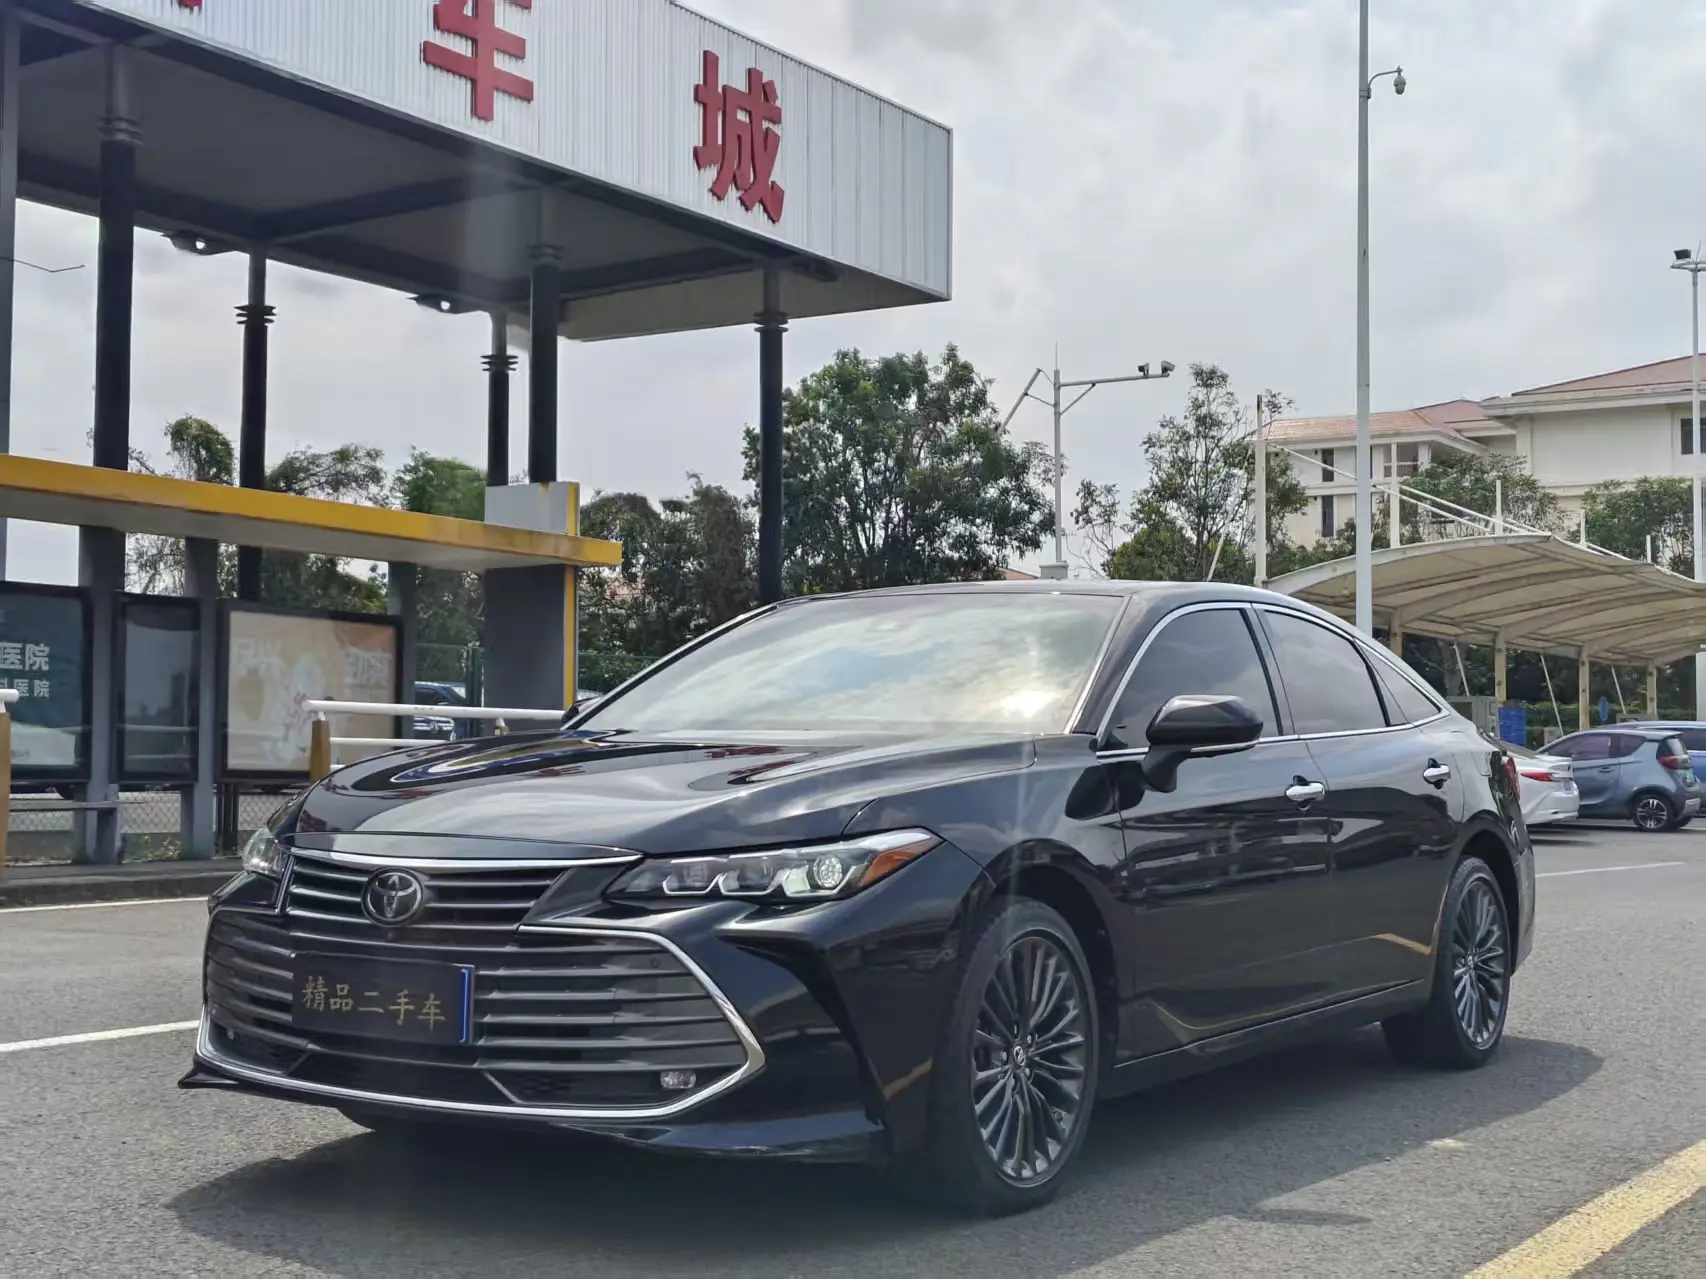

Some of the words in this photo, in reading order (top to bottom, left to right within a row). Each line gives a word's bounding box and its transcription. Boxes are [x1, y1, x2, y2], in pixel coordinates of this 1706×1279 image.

[0, 642, 50, 671] 医院
[302, 975, 446, 1031] 精品二手车
